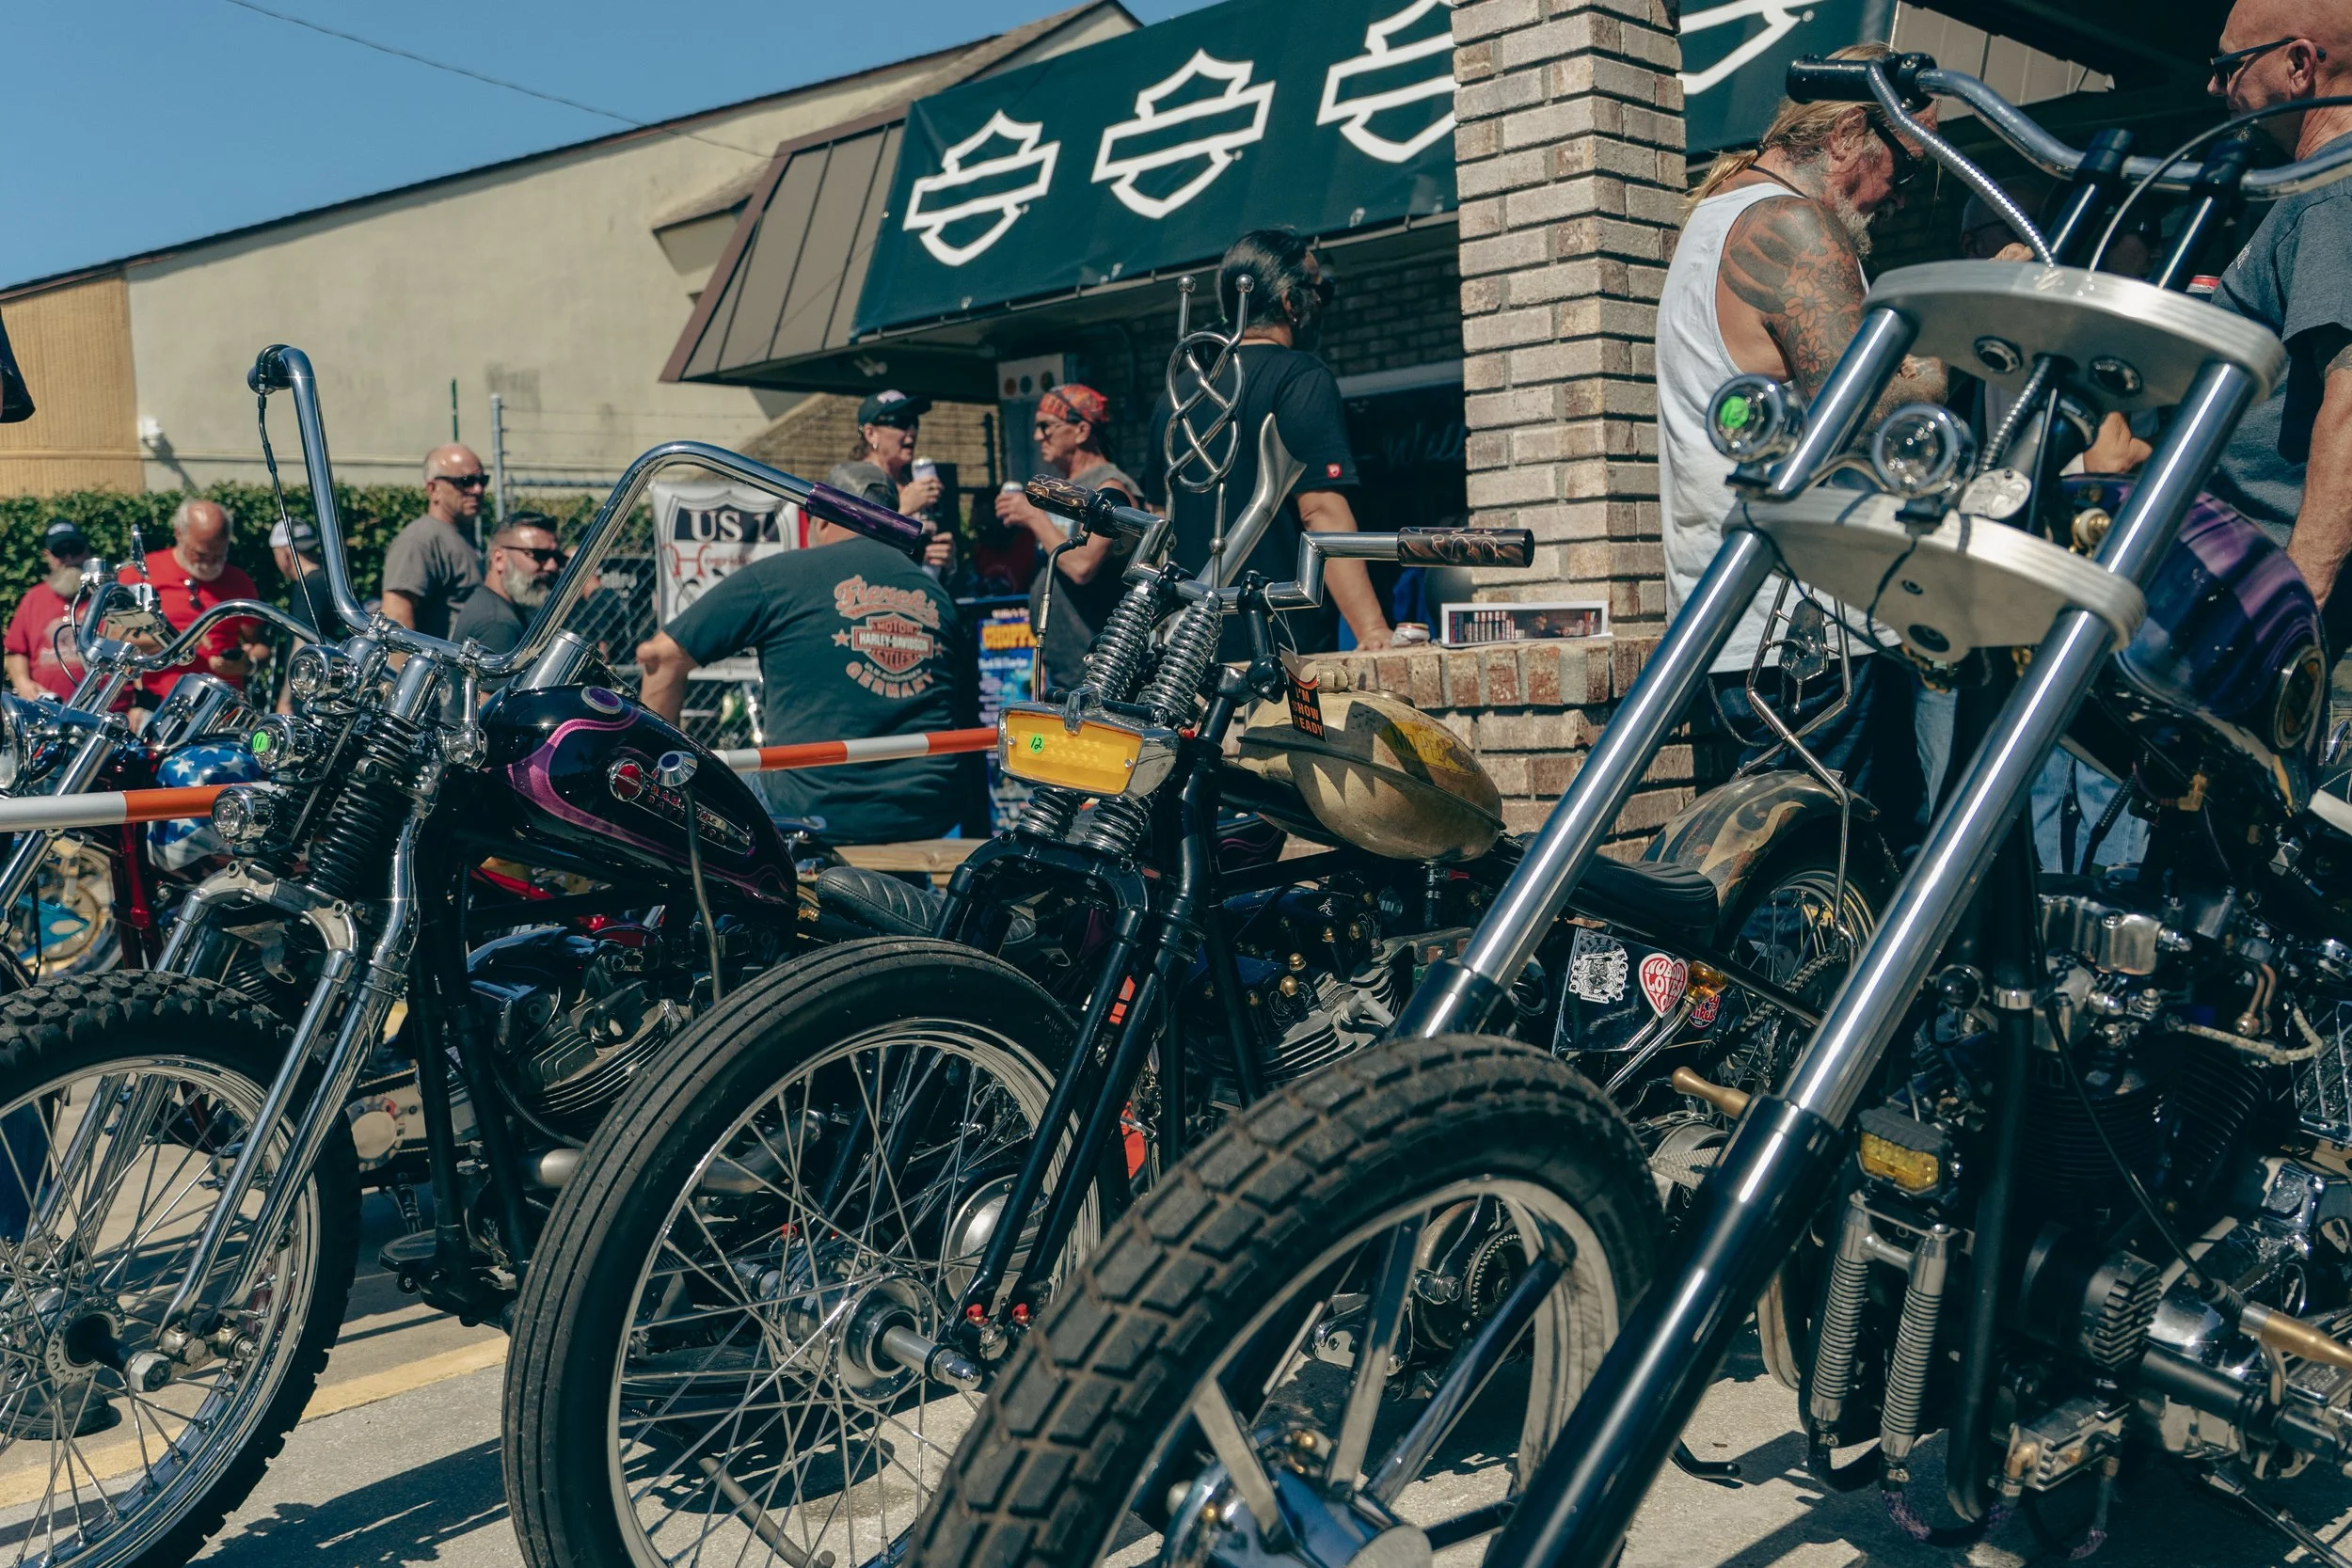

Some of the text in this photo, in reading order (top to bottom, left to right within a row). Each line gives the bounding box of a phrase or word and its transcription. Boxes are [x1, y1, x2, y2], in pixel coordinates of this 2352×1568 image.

[690, 510, 742, 542] US
[877, 621, 915, 635] MOTOR
[858, 631, 930, 652] HARLEY-DAVIDSON
[845, 661, 934, 699] GERMANY
[1295, 687, 1310, 703] I'M
[1291, 700, 1319, 721] SHOW
[1294, 714, 1324, 736] READY
[1030, 736, 1042, 750] 12
[1645, 959, 1684, 981] NOBODY
[1645, 974, 1683, 997] LOVES
[1649, 990, 1677, 1012] YOU
